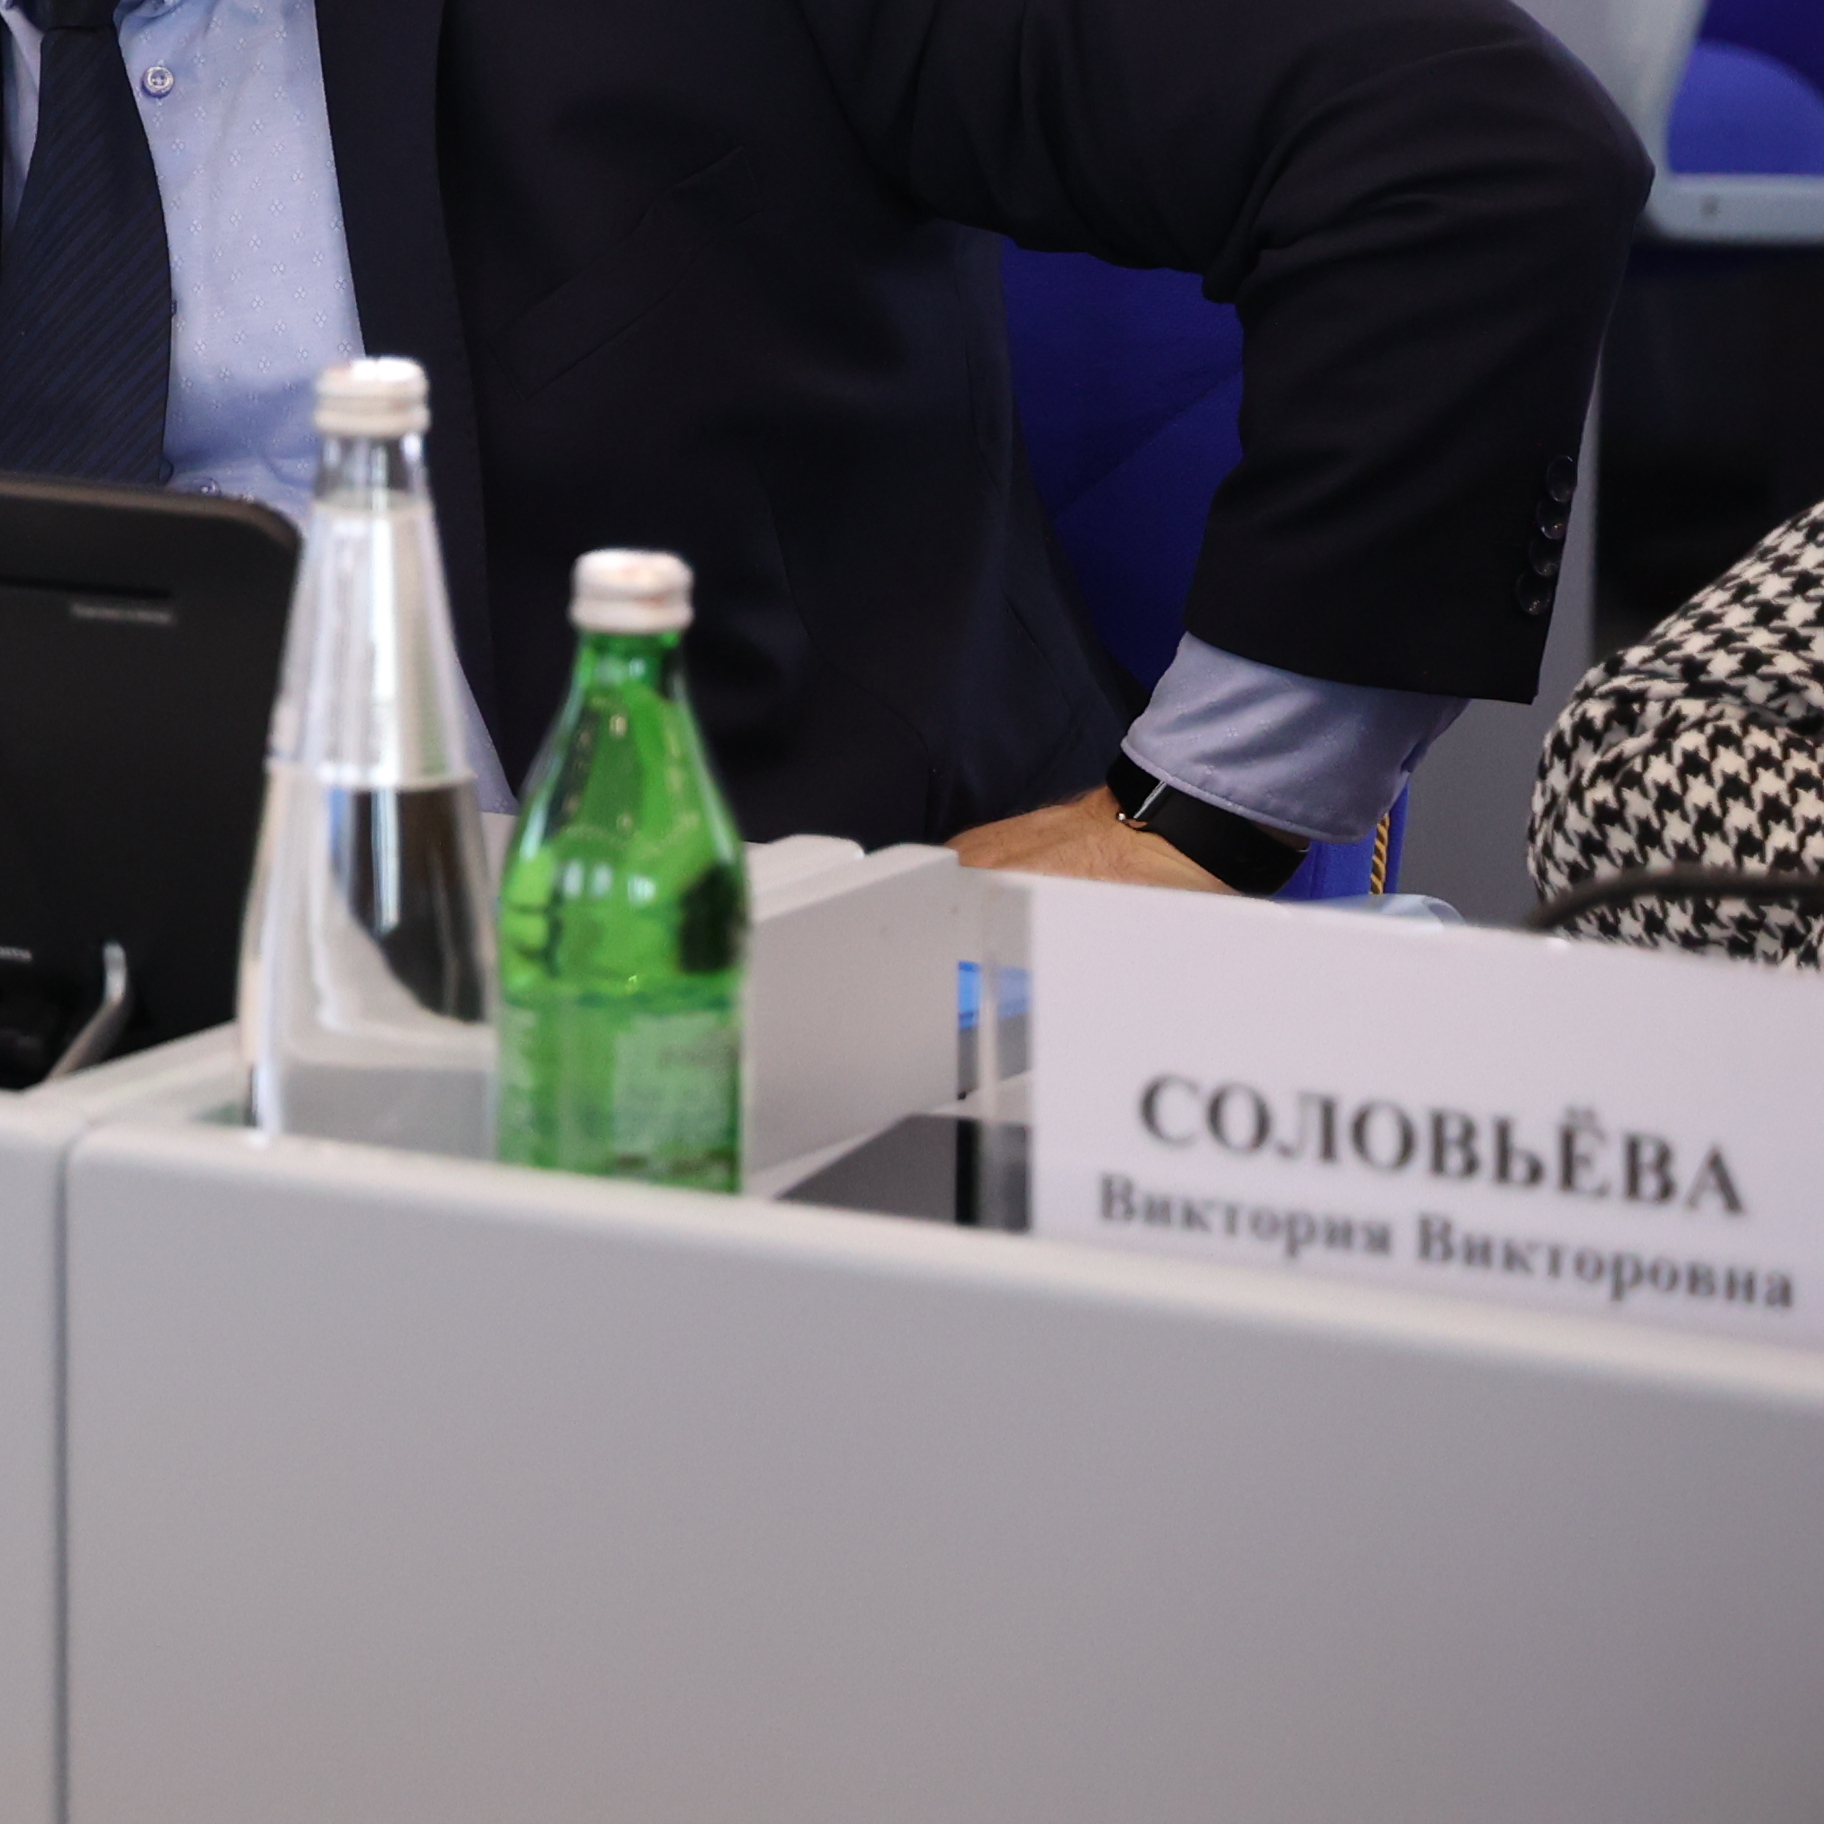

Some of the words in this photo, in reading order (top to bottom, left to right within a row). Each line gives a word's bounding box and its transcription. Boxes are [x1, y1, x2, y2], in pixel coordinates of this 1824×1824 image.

[1138, 1076, 1745, 1217] СОЛОВЬЁВА
[1099, 1175, 1392, 1259] Виктория
[1417, 1216, 1795, 1310] Викторовна
